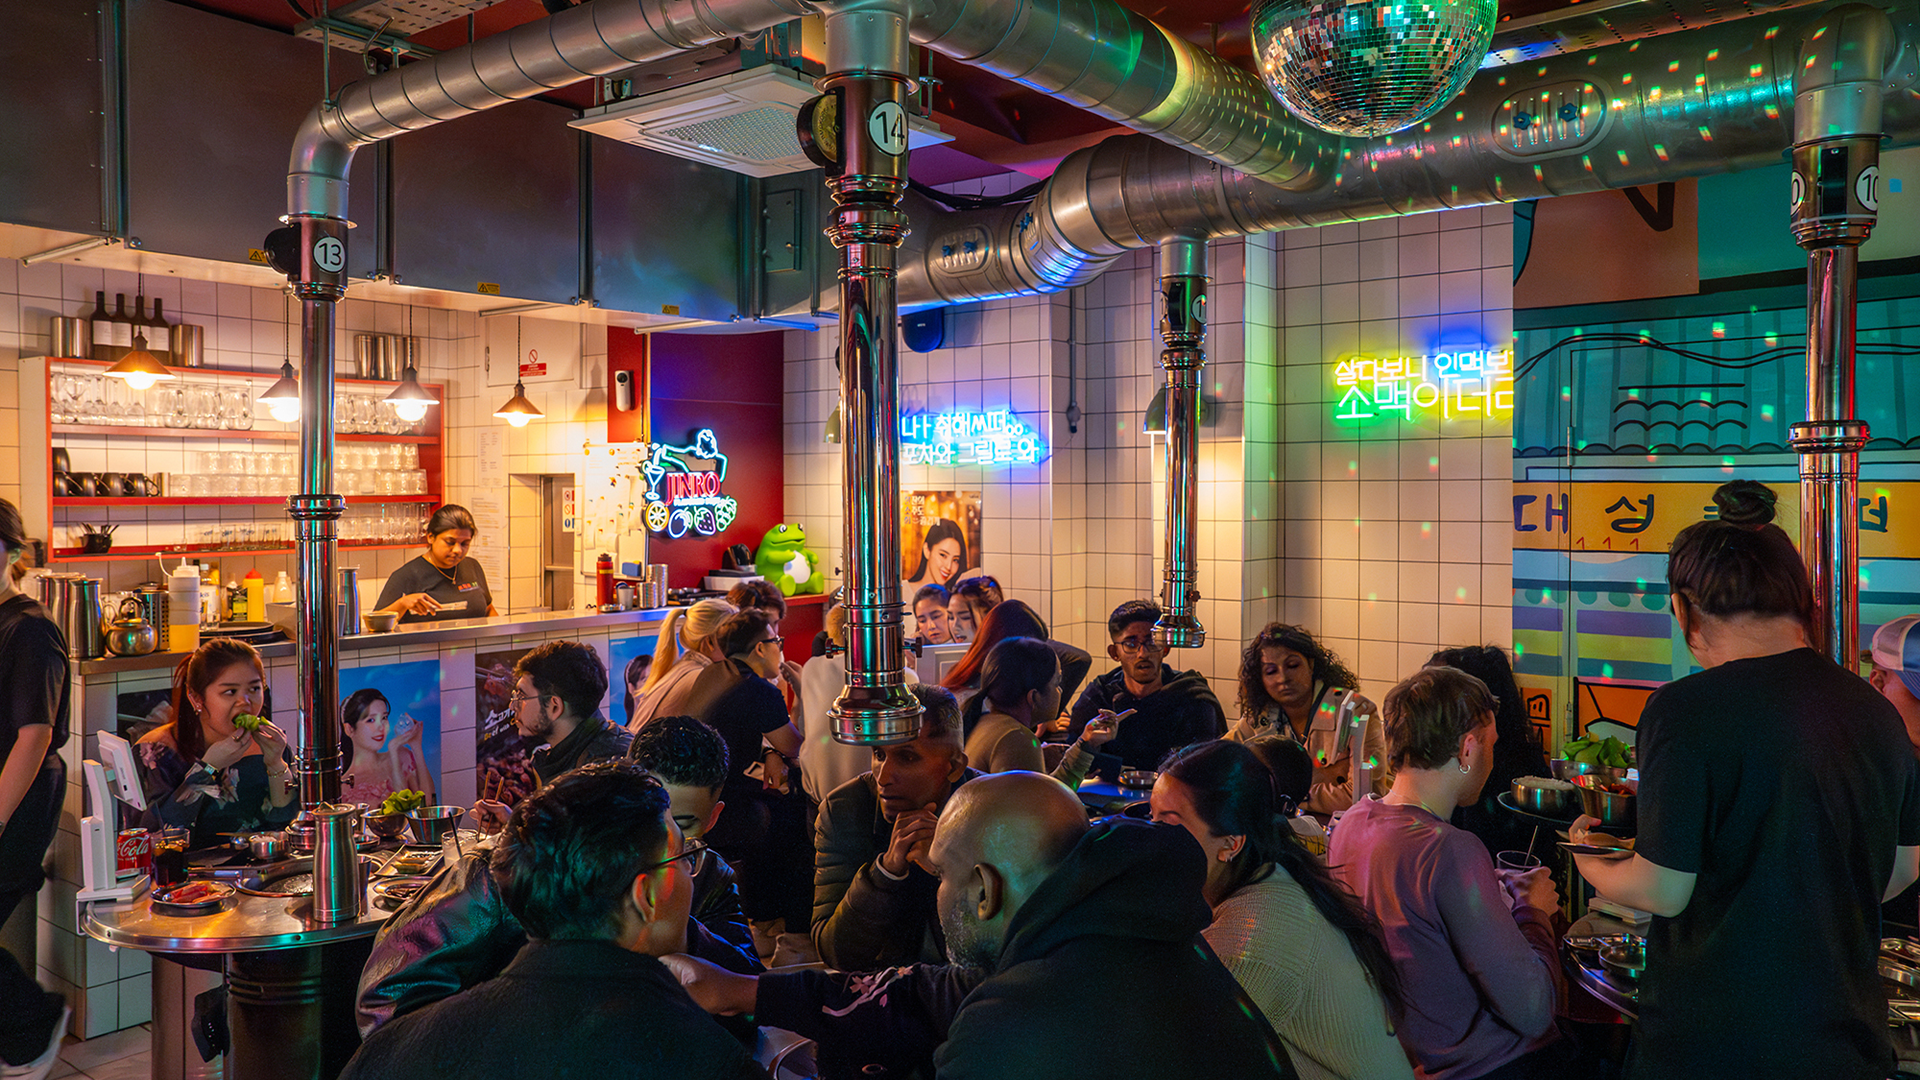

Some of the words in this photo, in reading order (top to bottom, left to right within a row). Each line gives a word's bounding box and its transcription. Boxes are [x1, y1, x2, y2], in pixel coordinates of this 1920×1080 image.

[876, 111, 905, 146] 14
[318, 242, 342, 266] 13
[1334, 354, 1427, 386] 살다보니
[1434, 349, 1514, 378] 인맥보
[1016, 437, 1040, 463] 와
[665, 471, 721, 507] JINRO
